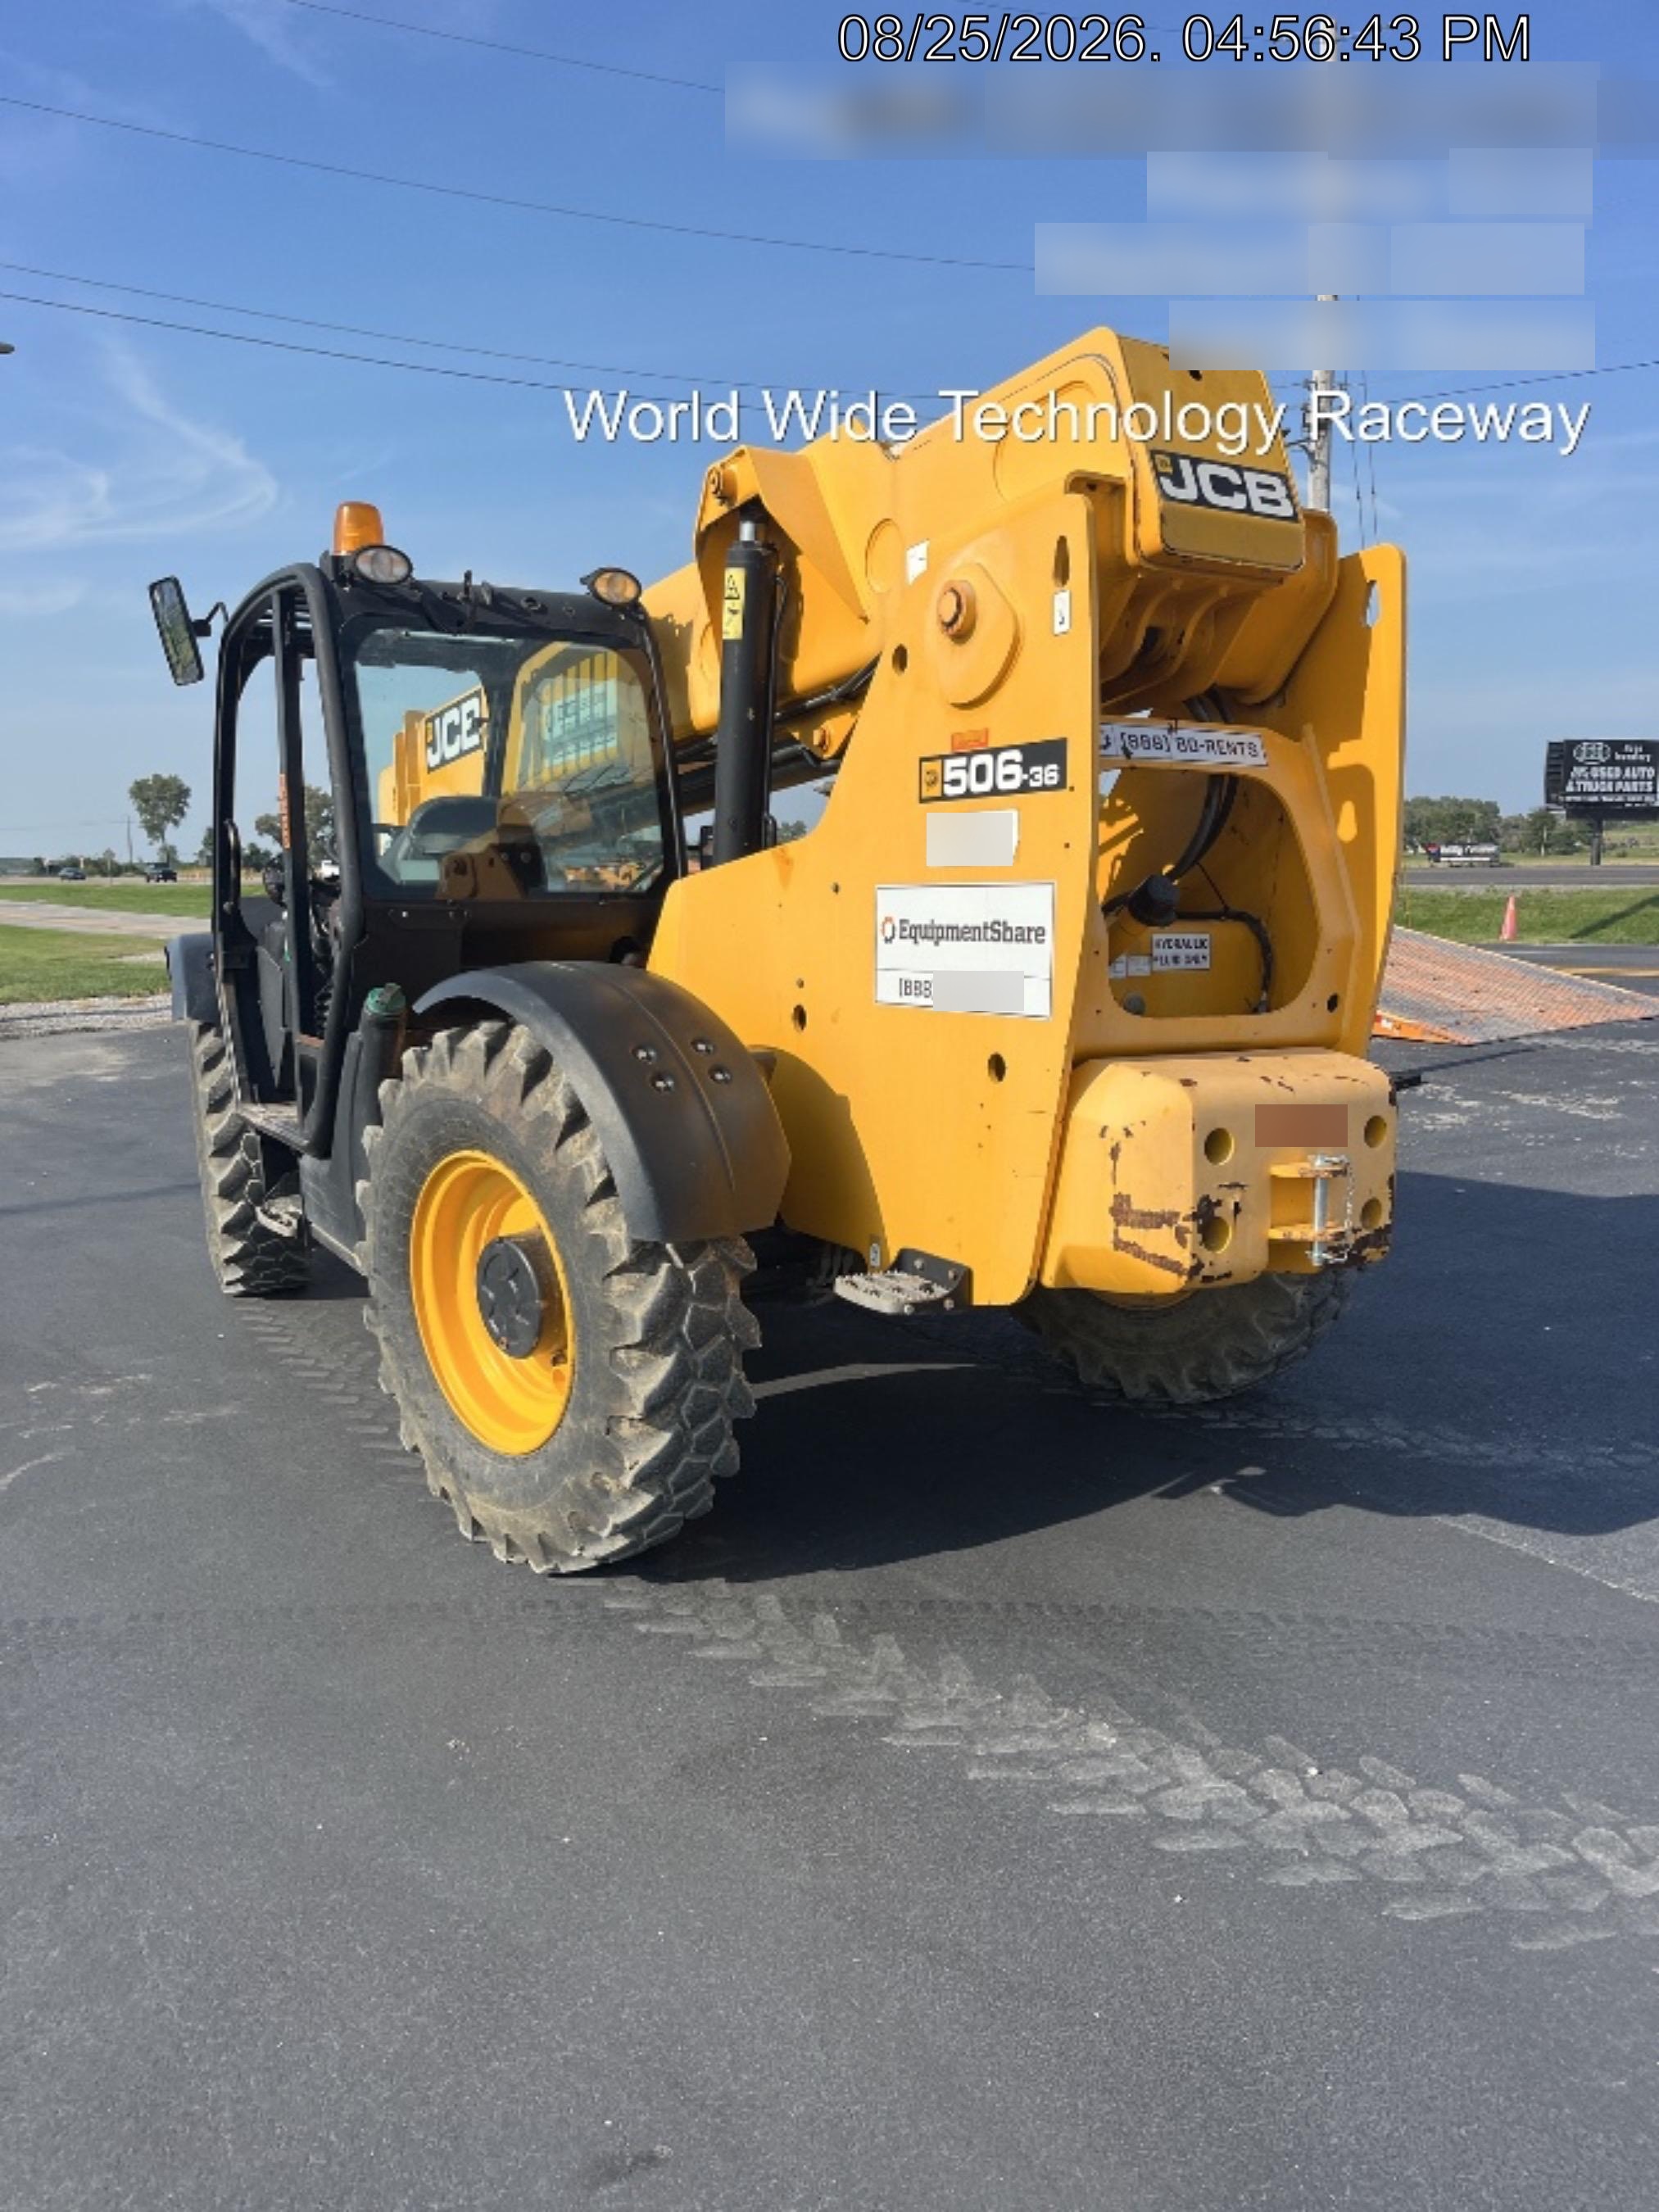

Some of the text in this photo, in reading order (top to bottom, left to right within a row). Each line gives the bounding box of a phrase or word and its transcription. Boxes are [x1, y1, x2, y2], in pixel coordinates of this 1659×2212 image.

[1159, 459, 1294, 517] JCB
[943, 749, 1060, 797] 506-36
[899, 918, 1045, 946] EquipmentShare
